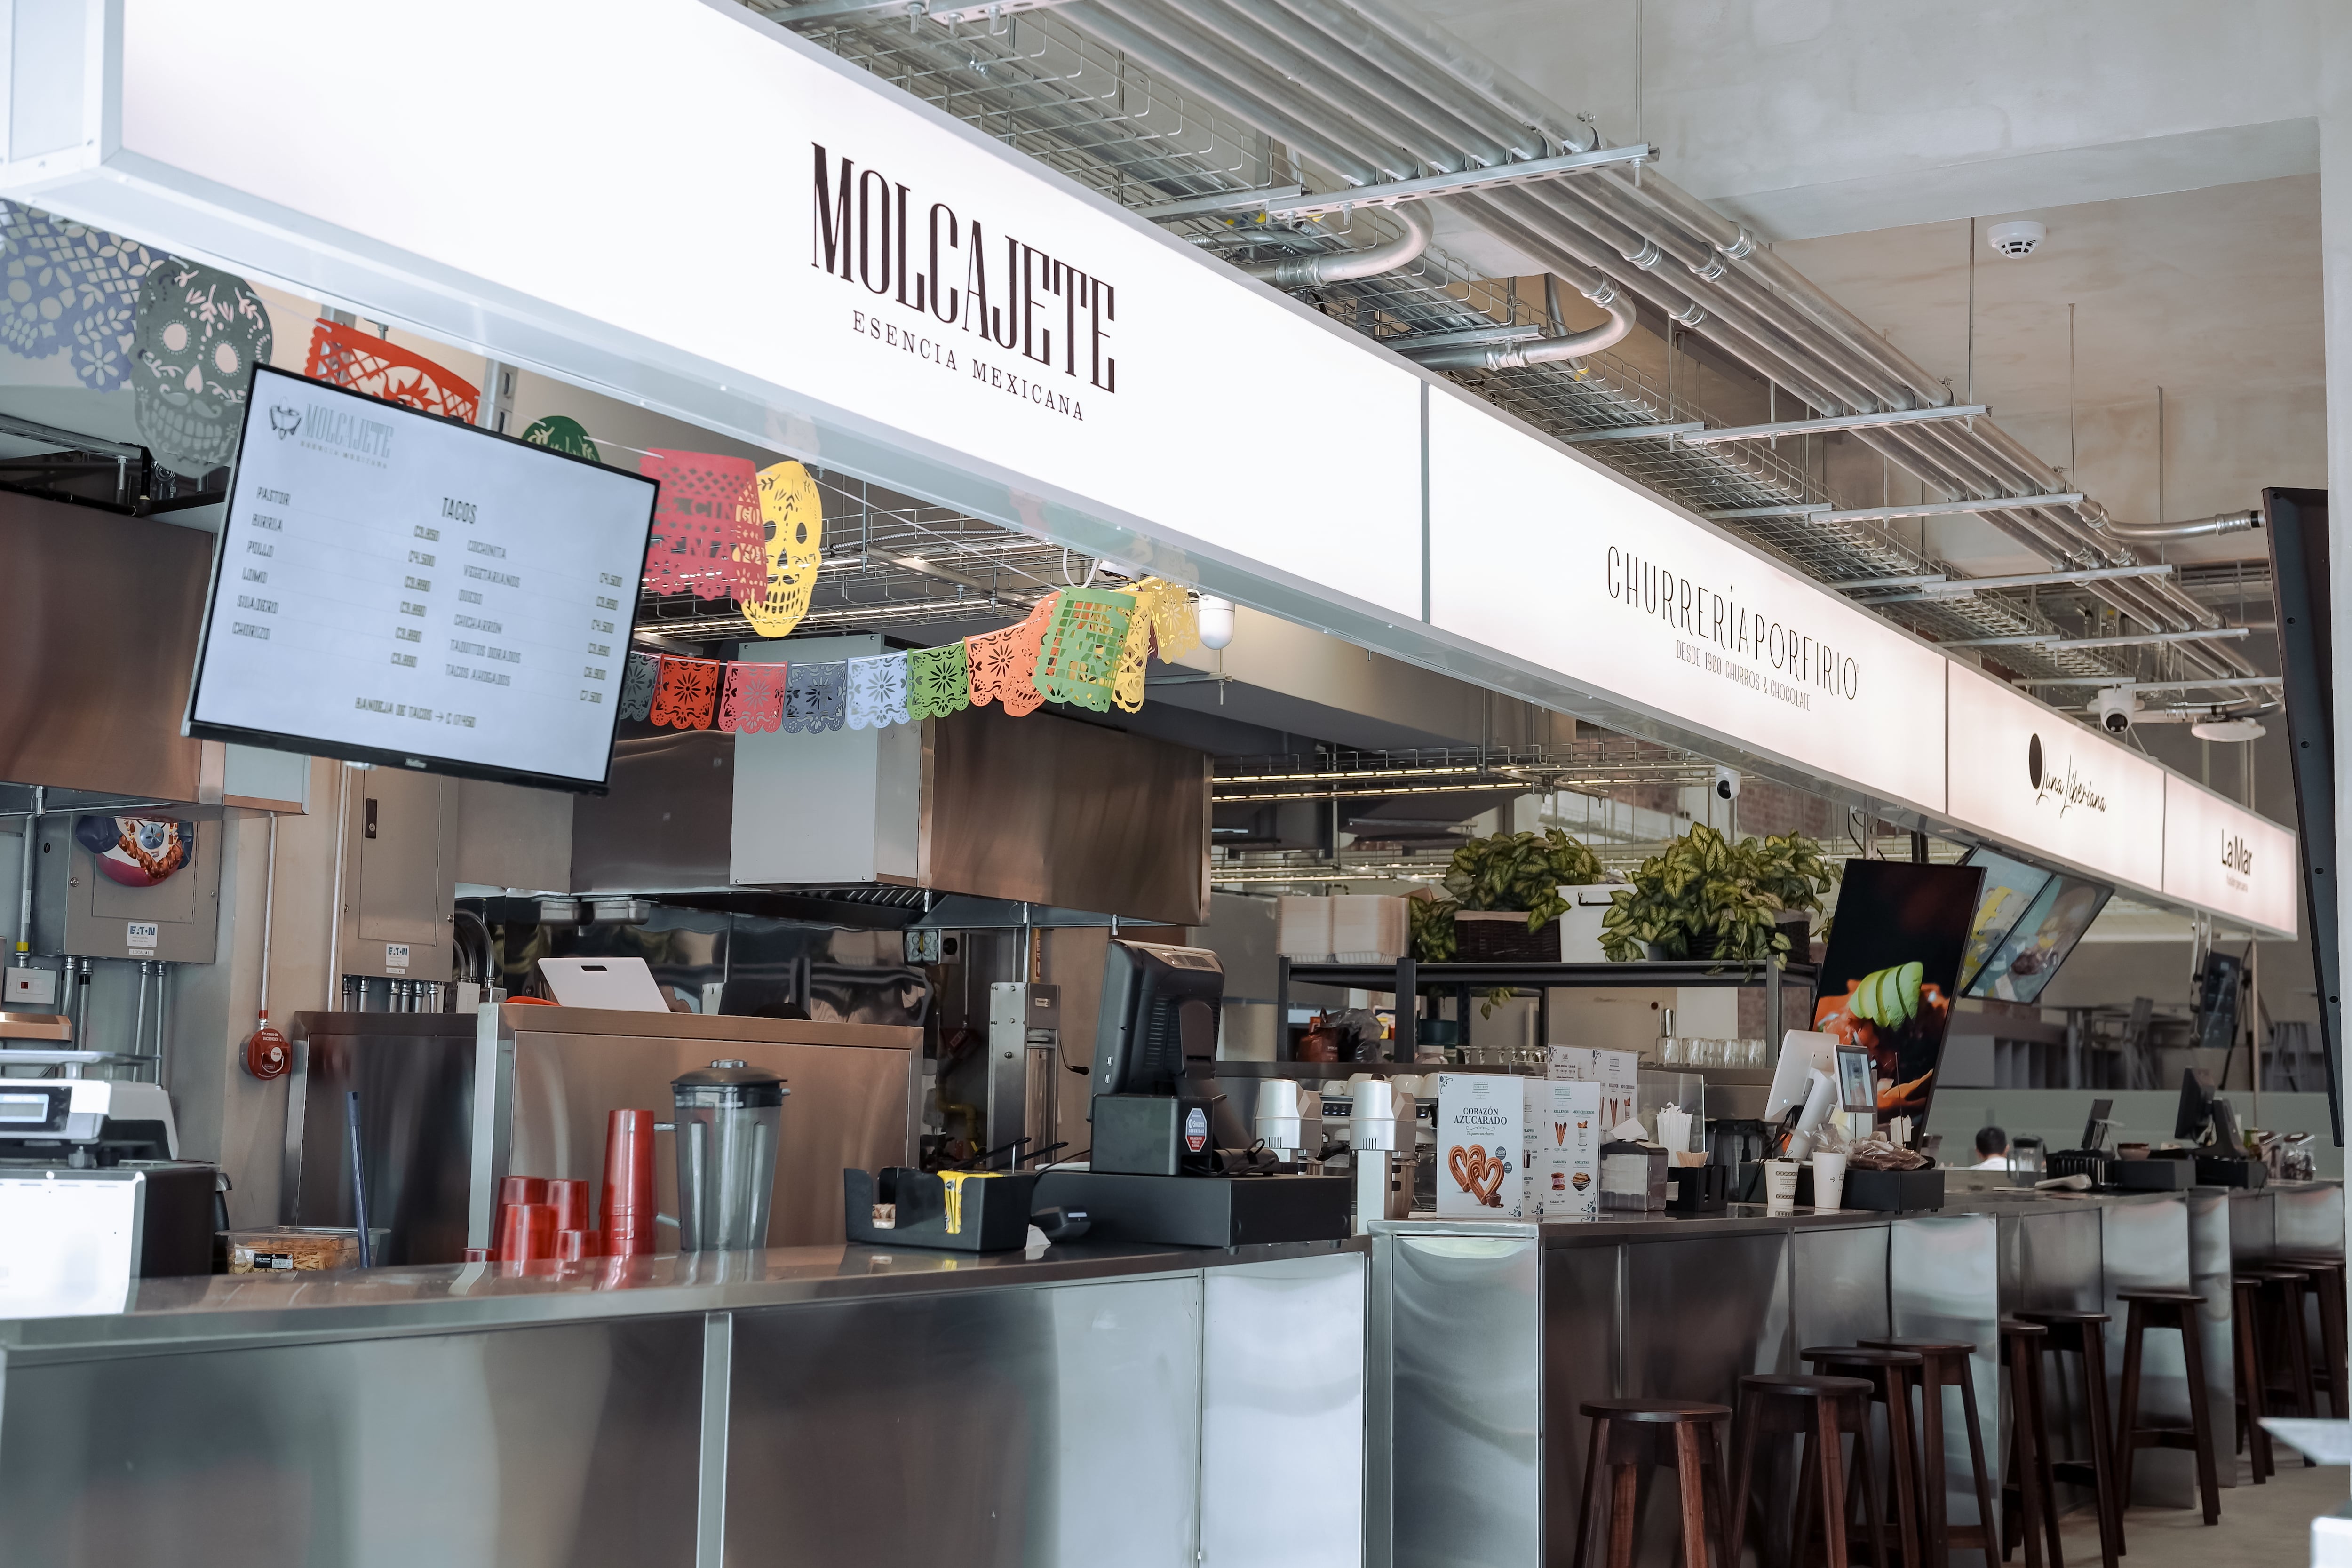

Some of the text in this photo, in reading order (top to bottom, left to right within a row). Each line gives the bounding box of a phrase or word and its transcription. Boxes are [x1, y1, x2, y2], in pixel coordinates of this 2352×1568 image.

[811, 141, 1115, 394] MOLCAJETE
[853, 310, 1083, 421] ESENCIA MEXICANA
[303, 403, 394, 459] MOLCAJETE
[442, 497, 477, 524] TACOS
[246, 541, 275, 557] POLLO
[241, 567, 269, 584] LOMO
[1677, 640, 1811, 712] DESDE 1900 CHURROS & CHOCOLATE
[2221, 828, 2252, 876] La Mar
[130, 926, 155, 935] EATON
[388, 947, 407, 955] EATON
[1454, 1115, 1507, 1125] AZUCARADO
[1463, 1106, 1498, 1115] CORAZÓN
